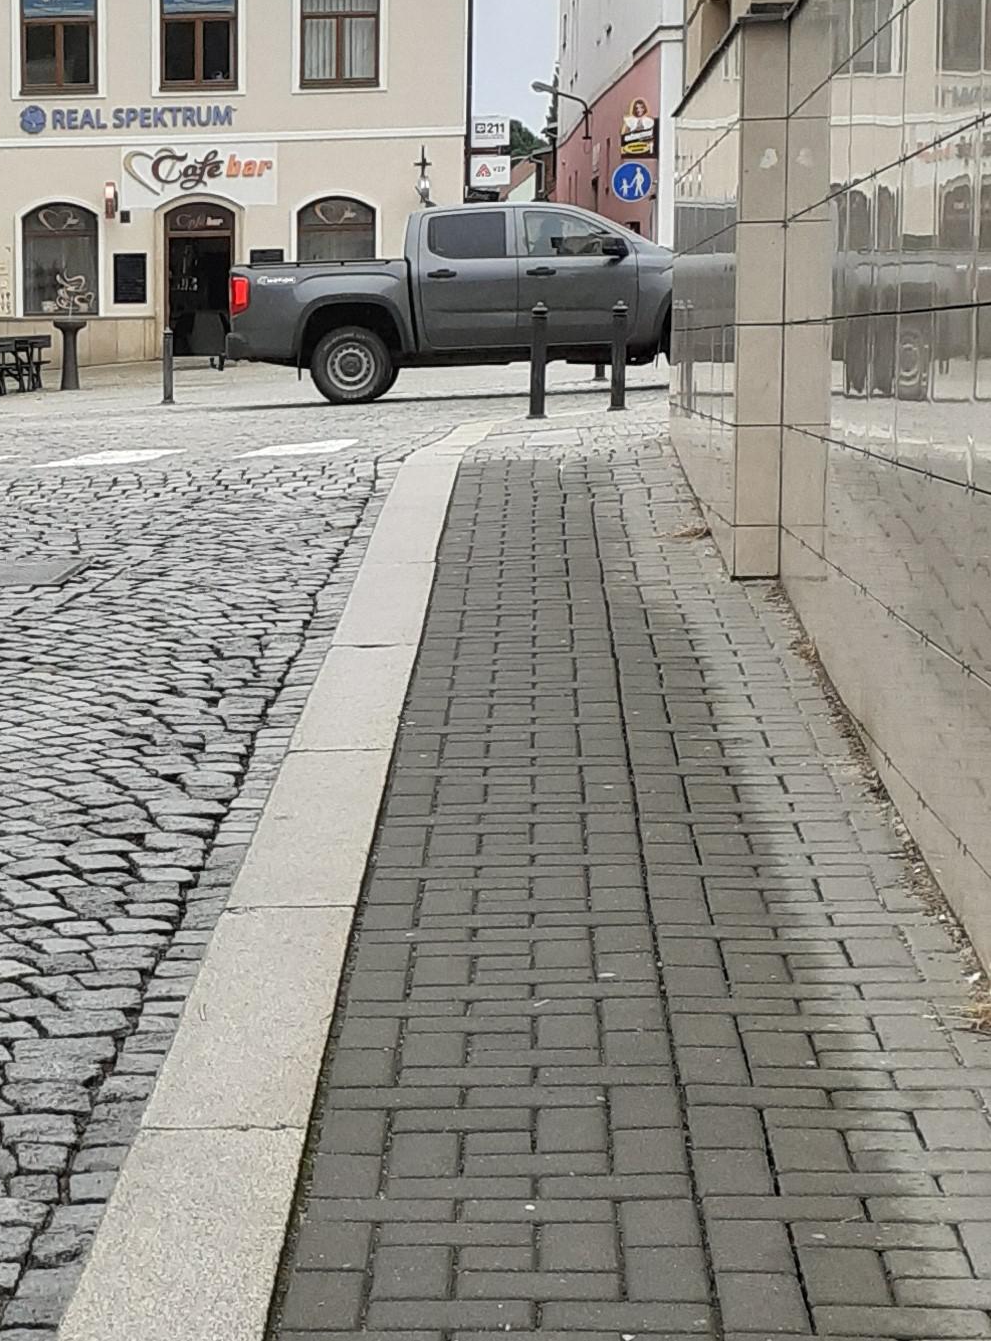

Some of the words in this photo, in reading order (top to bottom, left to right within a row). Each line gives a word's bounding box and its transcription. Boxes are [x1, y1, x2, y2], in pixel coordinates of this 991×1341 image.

[51, 109, 107, 130] REAL
[112, 106, 233, 129] SPEKTRUM
[487, 122, 505, 134] 211
[225, 153, 273, 178] bar
